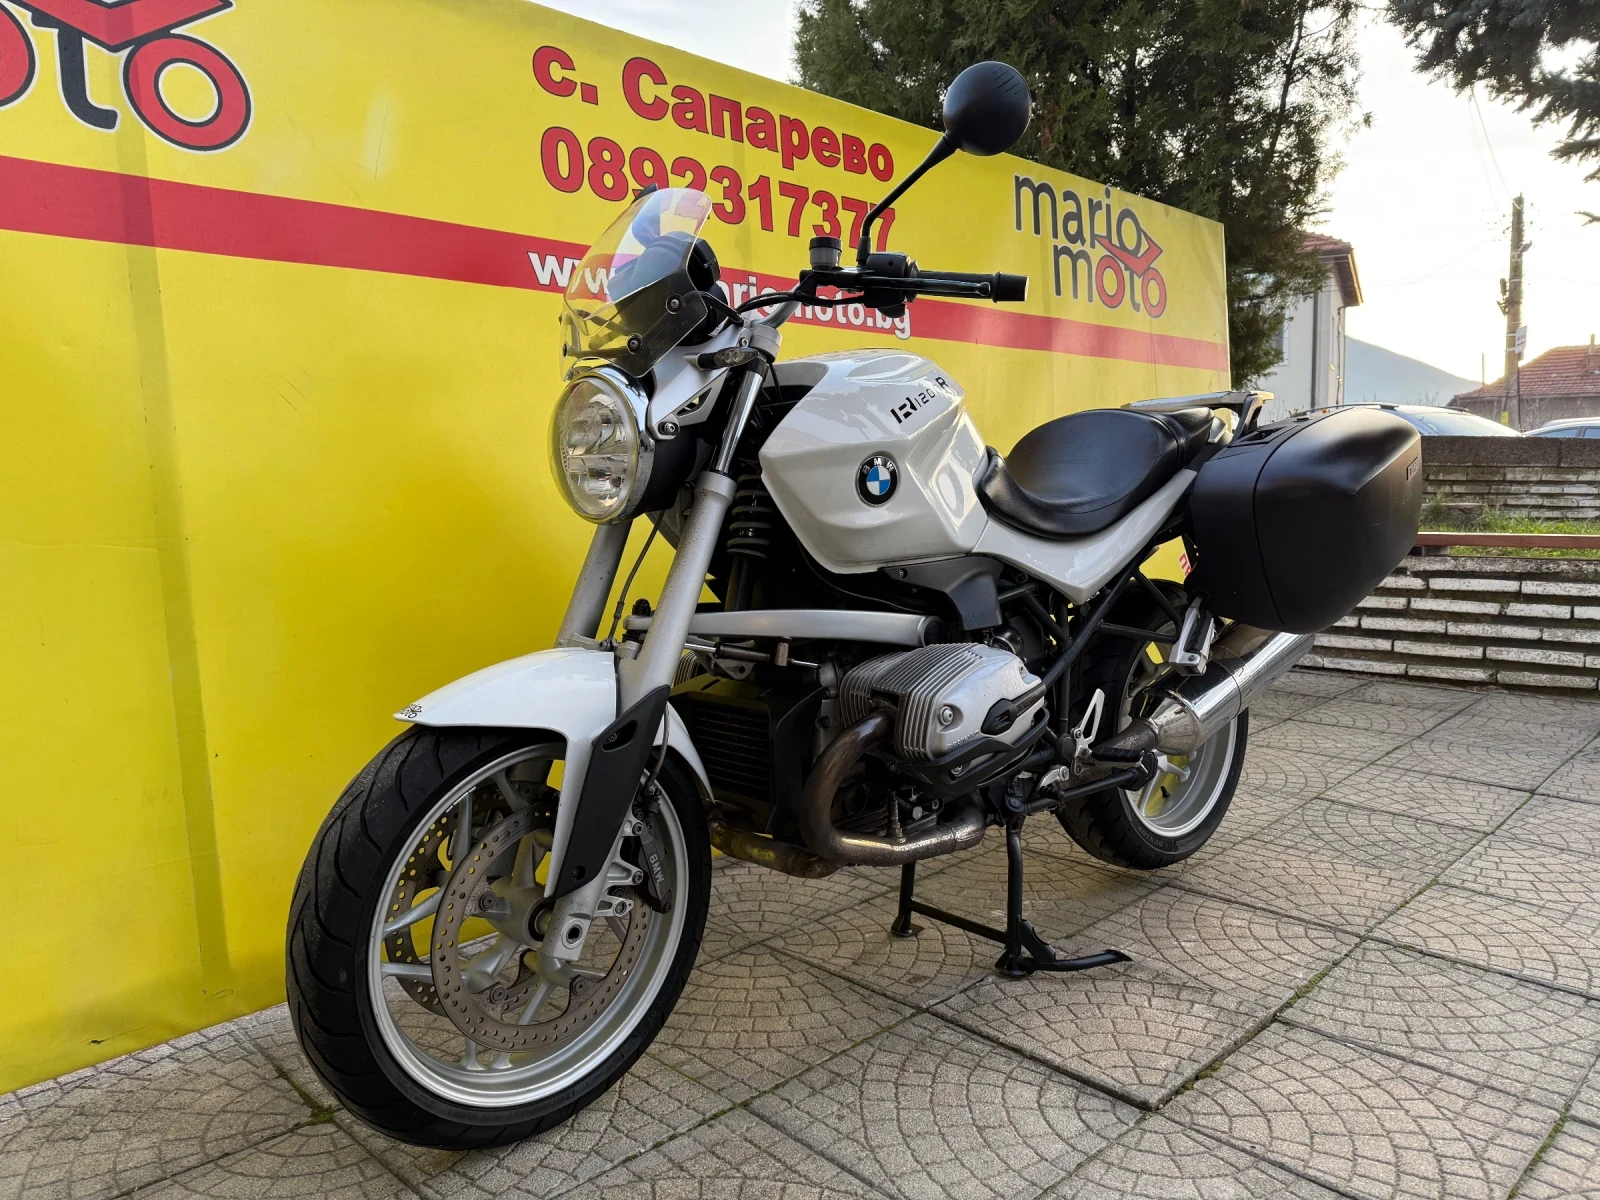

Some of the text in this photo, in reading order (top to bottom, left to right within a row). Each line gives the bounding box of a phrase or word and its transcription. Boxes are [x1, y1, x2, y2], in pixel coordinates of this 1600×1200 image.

[533, 46, 895, 182] с. Сапарево
[541, 127, 895, 251] 0892317377
[1014, 175, 1142, 258] mario
[1053, 244, 1167, 318] moto
[649, 853, 665, 883] BMW
